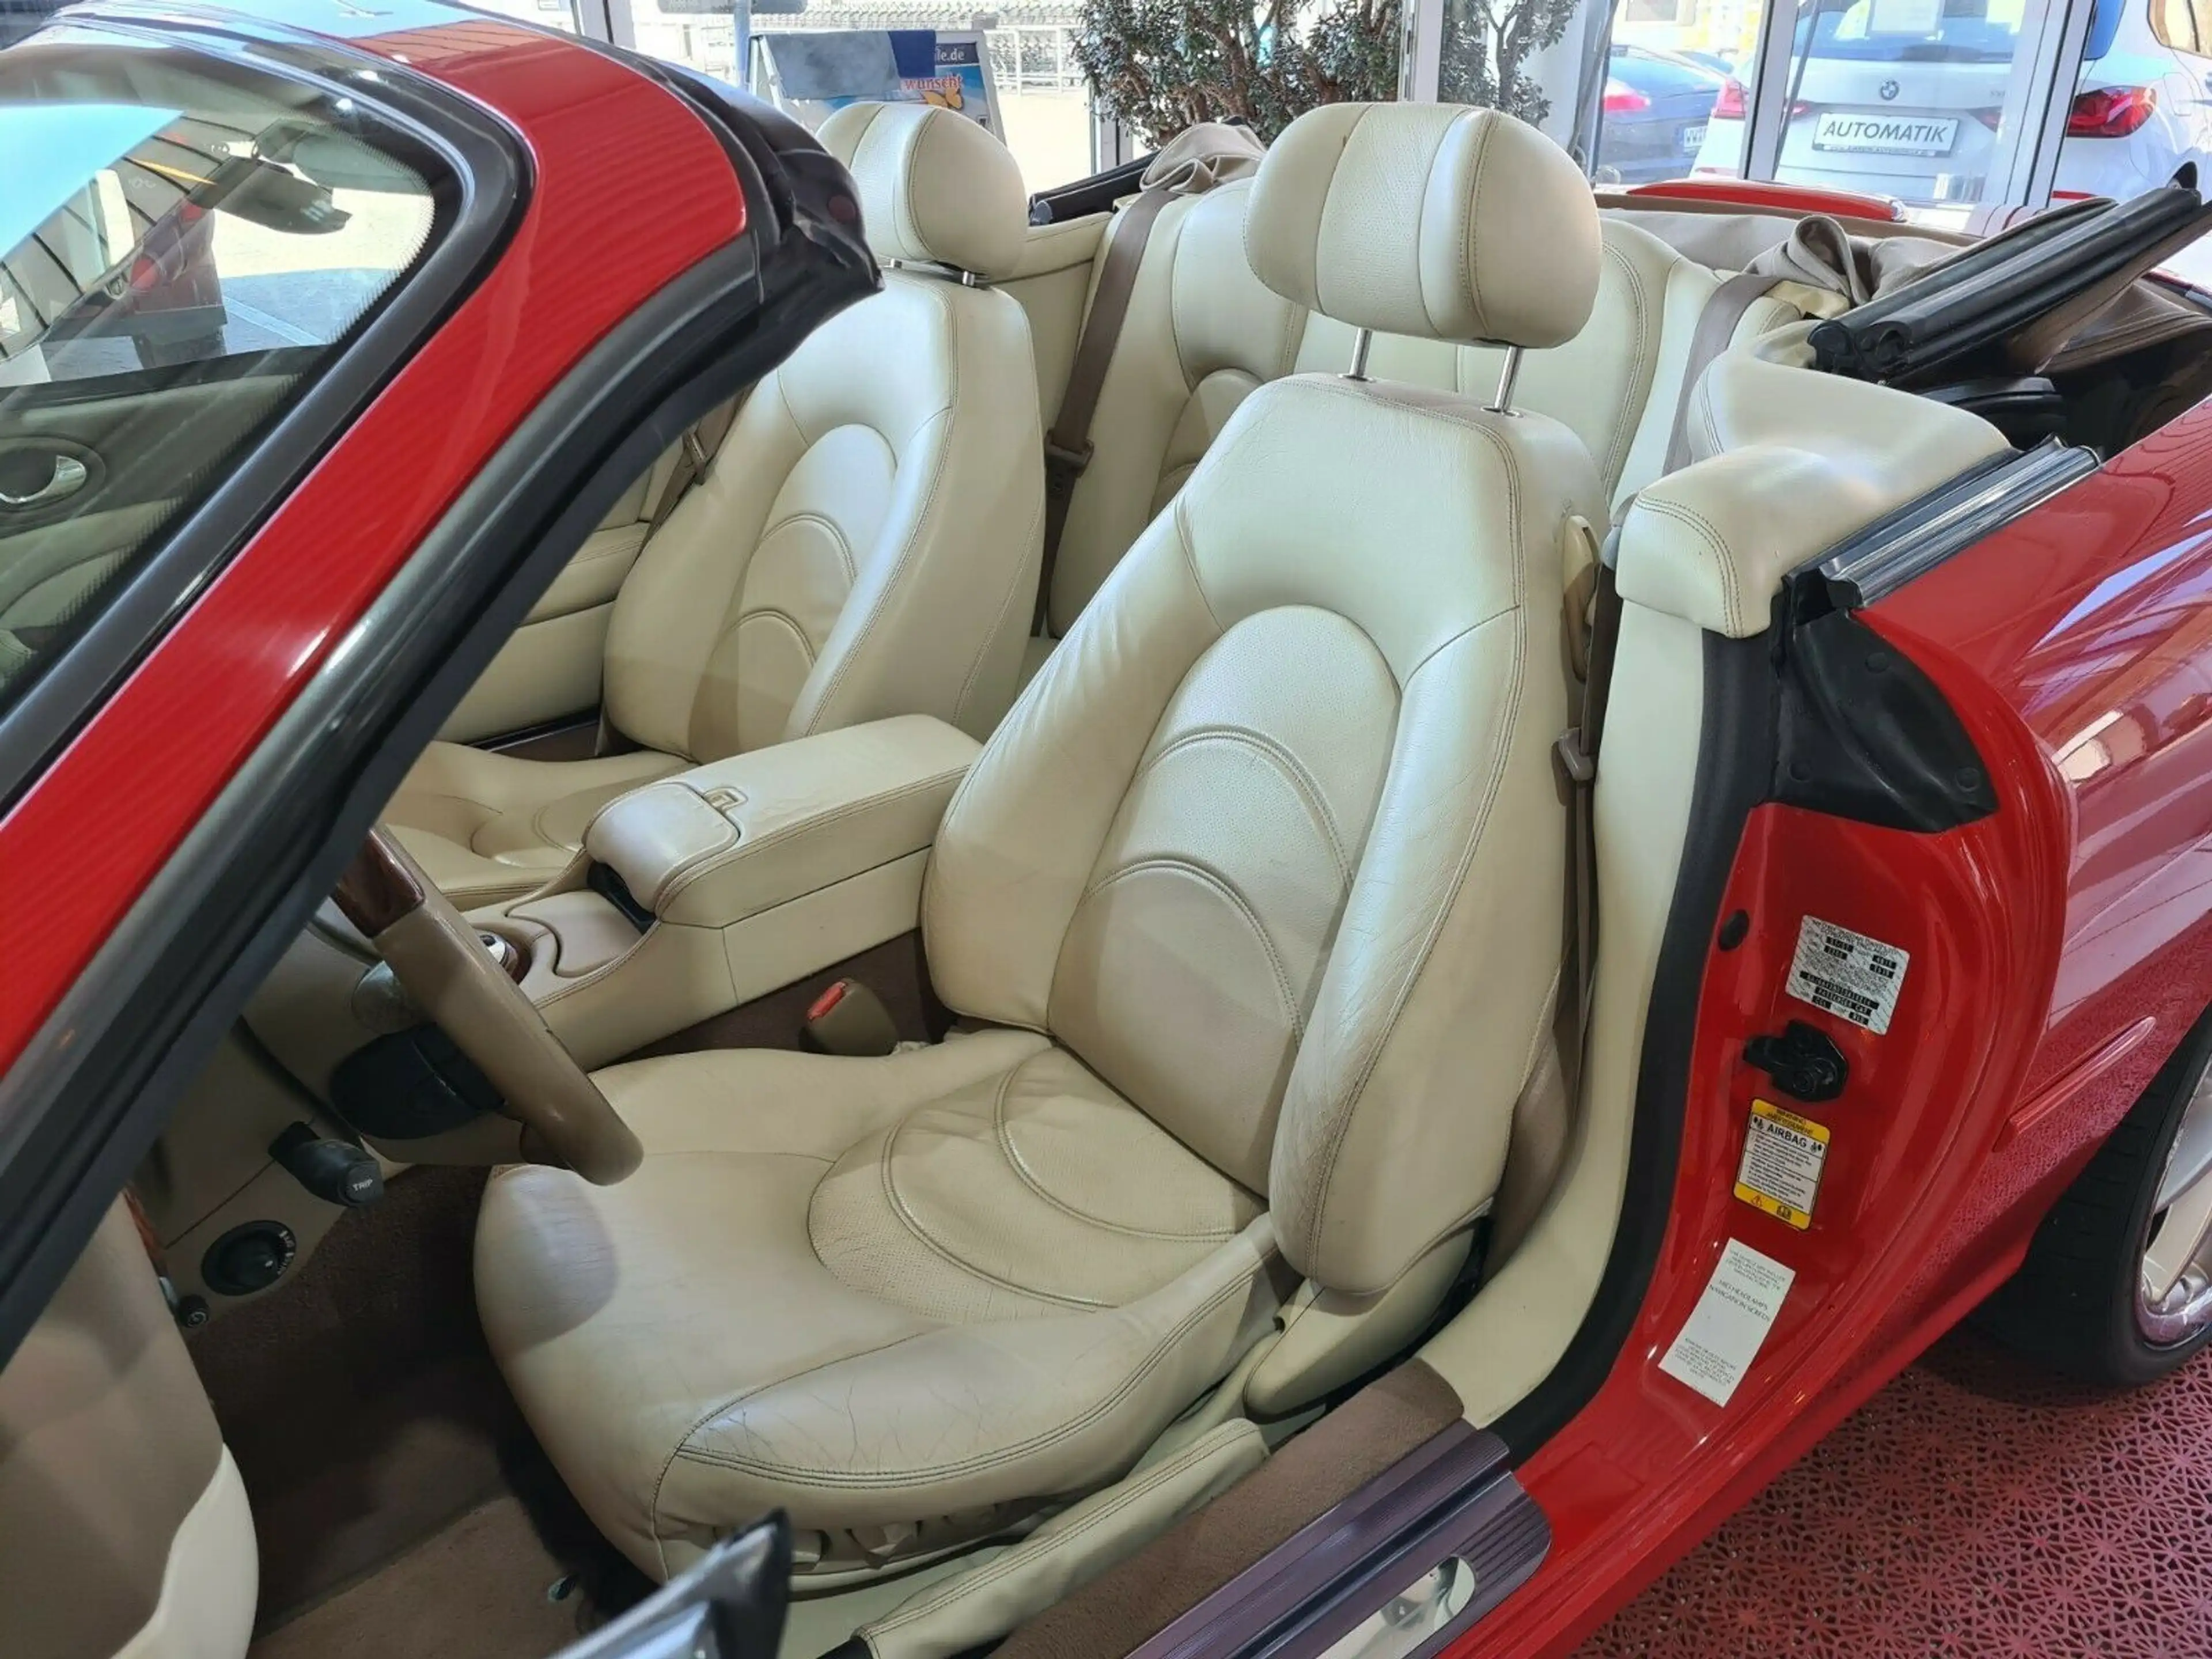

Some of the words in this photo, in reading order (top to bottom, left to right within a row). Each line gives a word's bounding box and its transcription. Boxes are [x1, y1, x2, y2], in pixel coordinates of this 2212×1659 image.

[1823, 121, 1948, 143] AUTOMATIK
[1767, 1124, 1807, 1147] AIRBAG
[353, 1179, 373, 1191] TRIP
